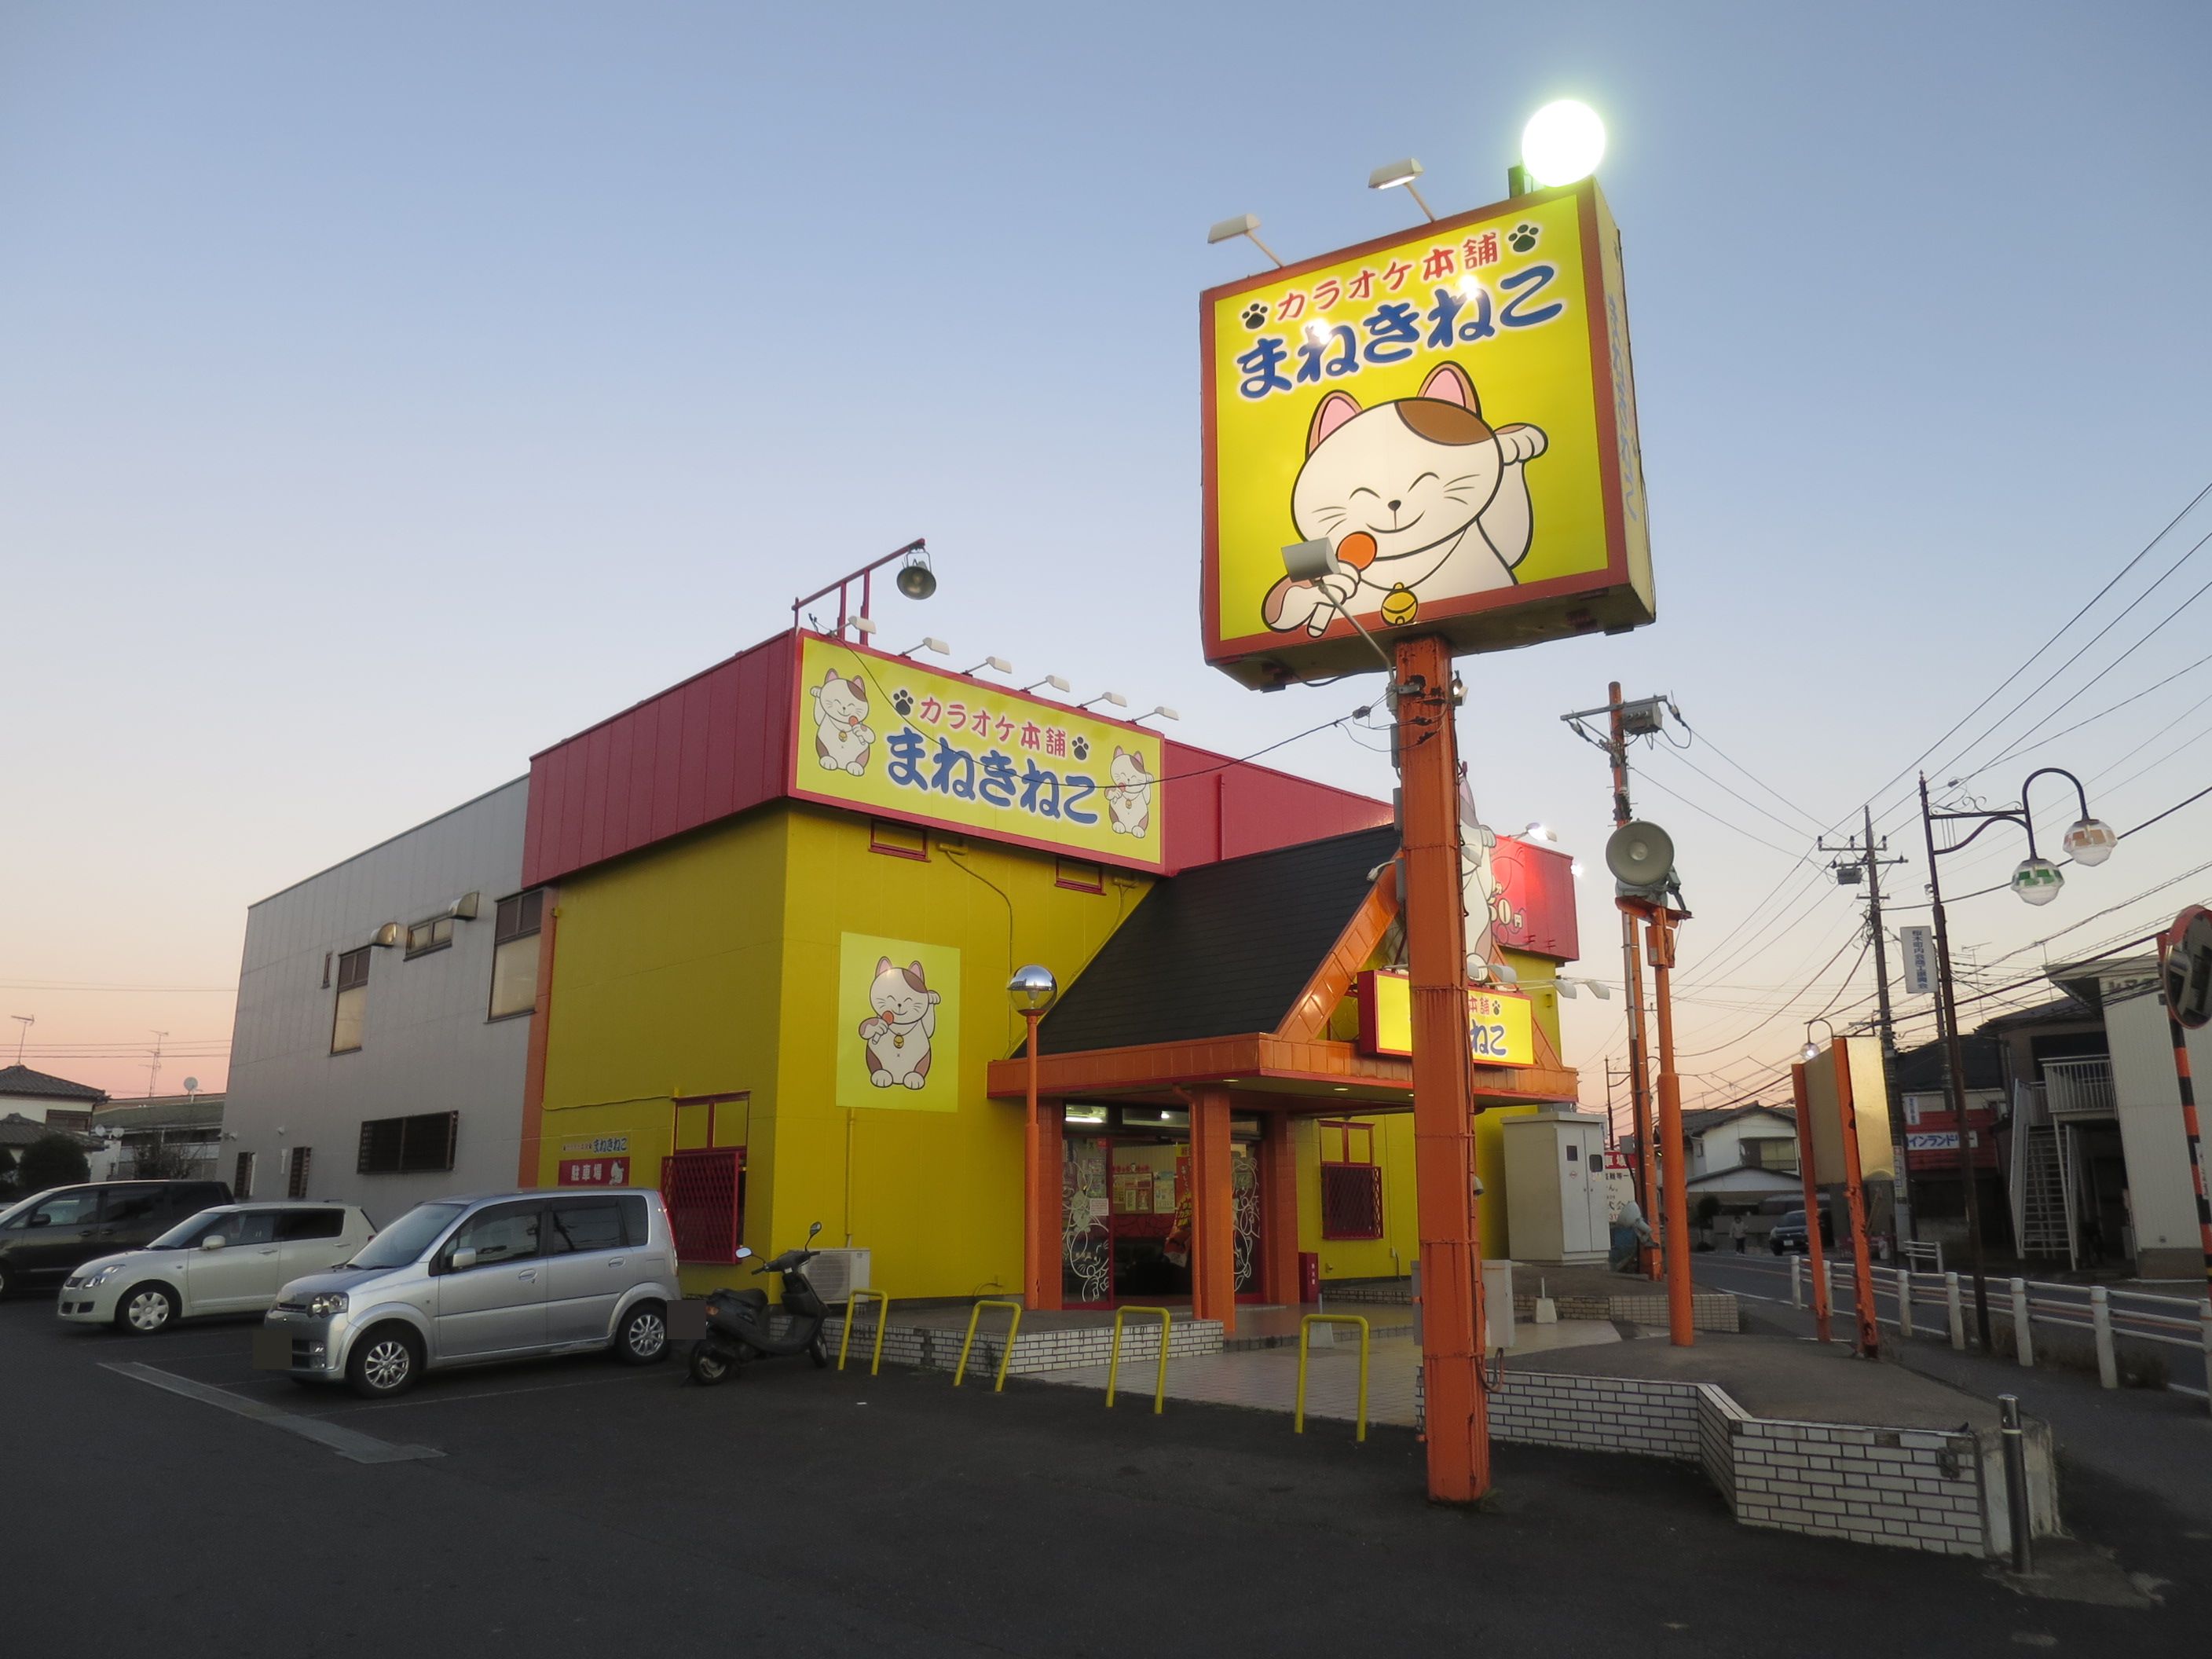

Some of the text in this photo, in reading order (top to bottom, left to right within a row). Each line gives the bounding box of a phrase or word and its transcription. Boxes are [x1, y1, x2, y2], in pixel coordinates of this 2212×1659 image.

[1277, 232, 1498, 320] カラオケ本舗
[1236, 266, 1562, 398] まねきねこ
[920, 697, 1065, 757] カラオケ本舗
[887, 727, 1098, 824] まねきねこ
